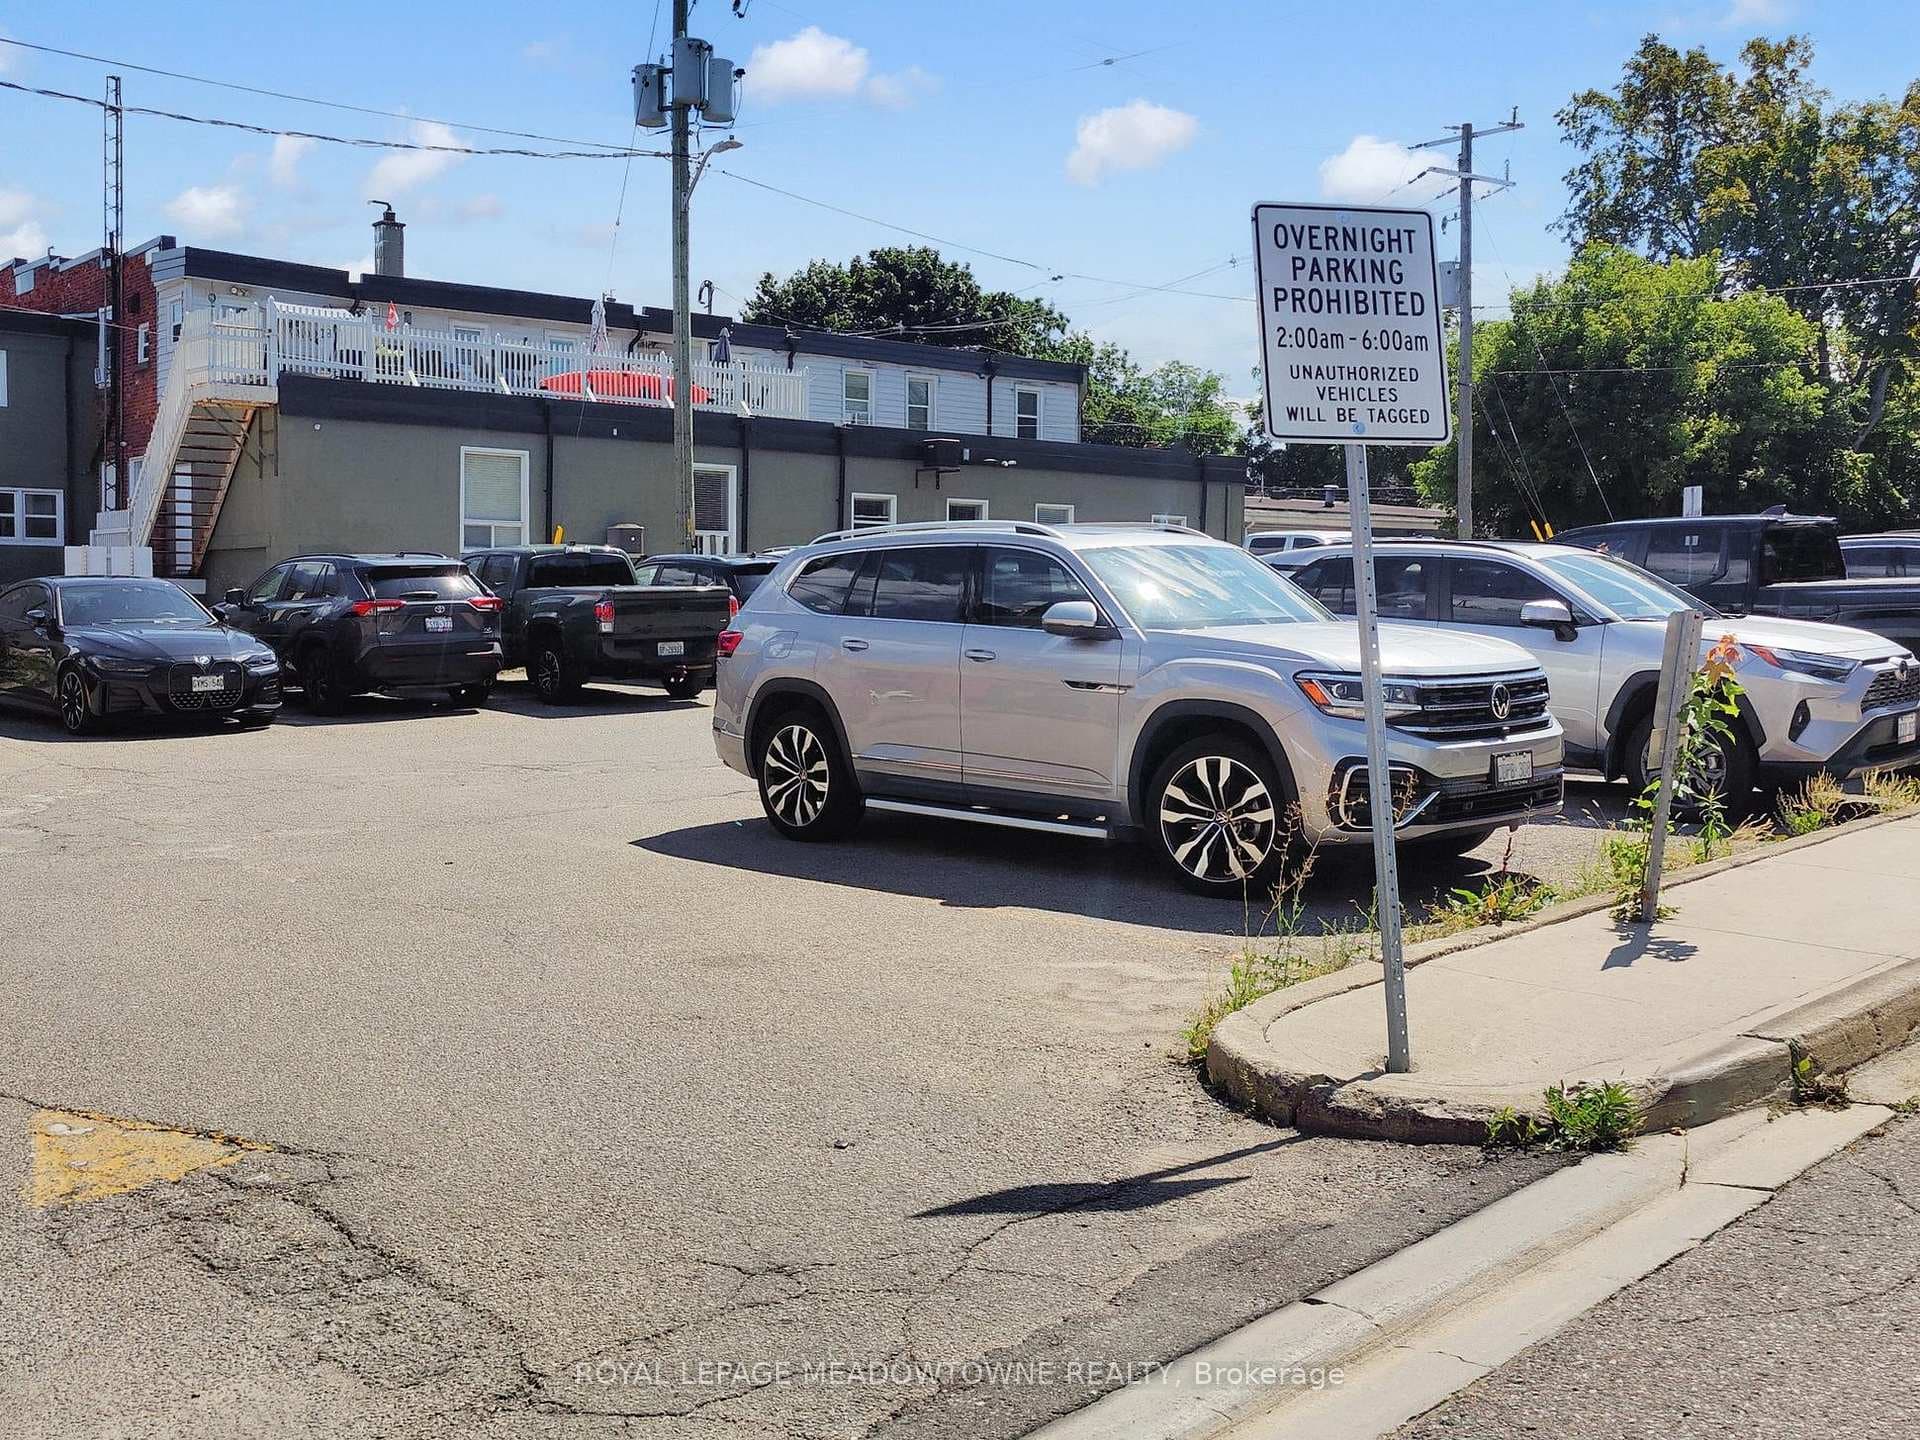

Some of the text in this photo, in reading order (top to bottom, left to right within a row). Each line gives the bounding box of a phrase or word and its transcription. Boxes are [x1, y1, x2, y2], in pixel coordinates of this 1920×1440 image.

[1273, 223, 1416, 254] OVERNIGHT
[1291, 256, 1404, 285] PARKING
[1273, 287, 1425, 316] PROHIBITED
[1290, 364, 1419, 382] UNAUTHORIZED
[1316, 386, 1398, 402] VEHICLES
[1286, 406, 1430, 424] WILL BE TAGGED
